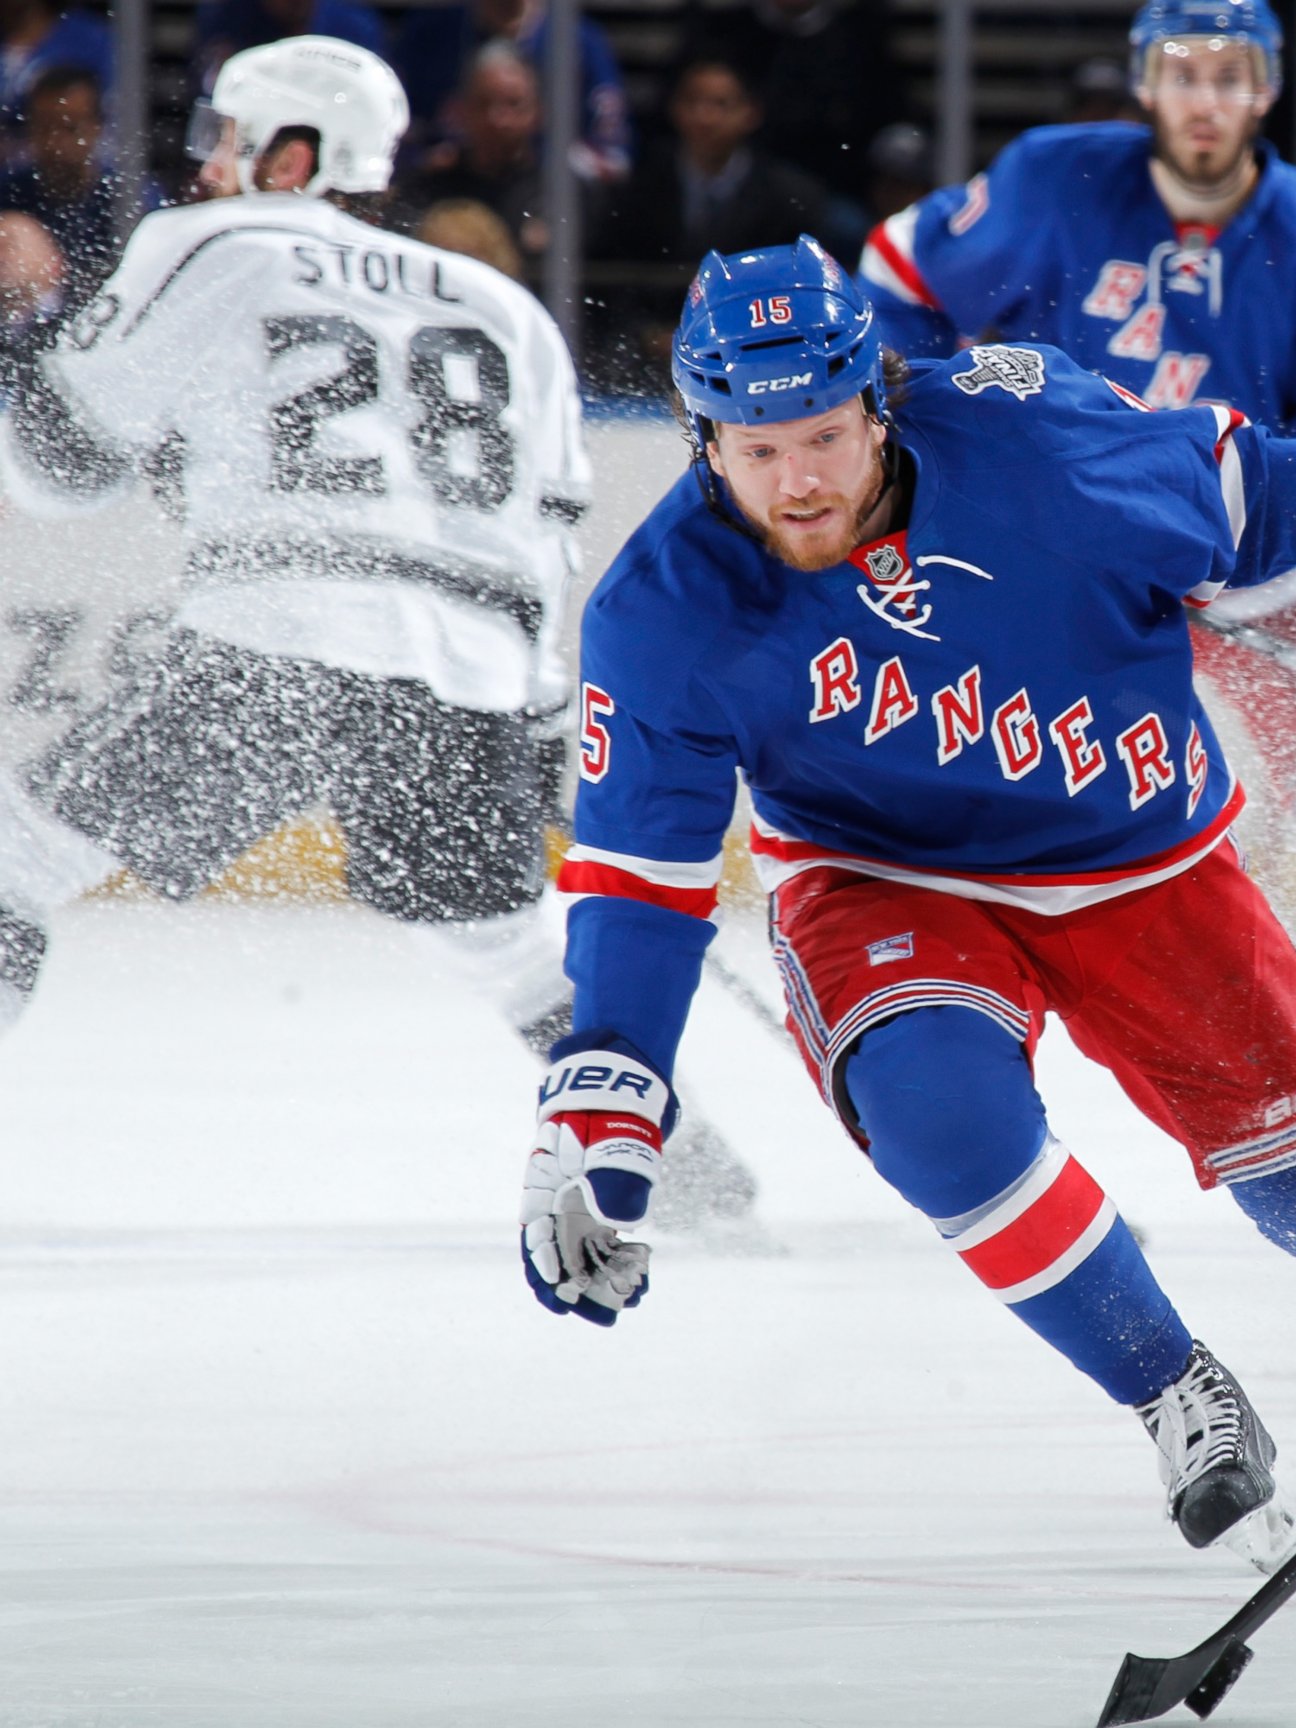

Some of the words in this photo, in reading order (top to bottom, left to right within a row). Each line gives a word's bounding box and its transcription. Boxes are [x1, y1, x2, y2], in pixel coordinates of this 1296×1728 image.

[293, 246, 462, 303] STOLL
[748, 296, 793, 328] 15
[747, 372, 814, 395] CCM
[1081, 259, 1216, 410] RAN
[262, 314, 516, 513] 28
[579, 681, 615, 784] 5
[808, 636, 1209, 821] RANGERS
